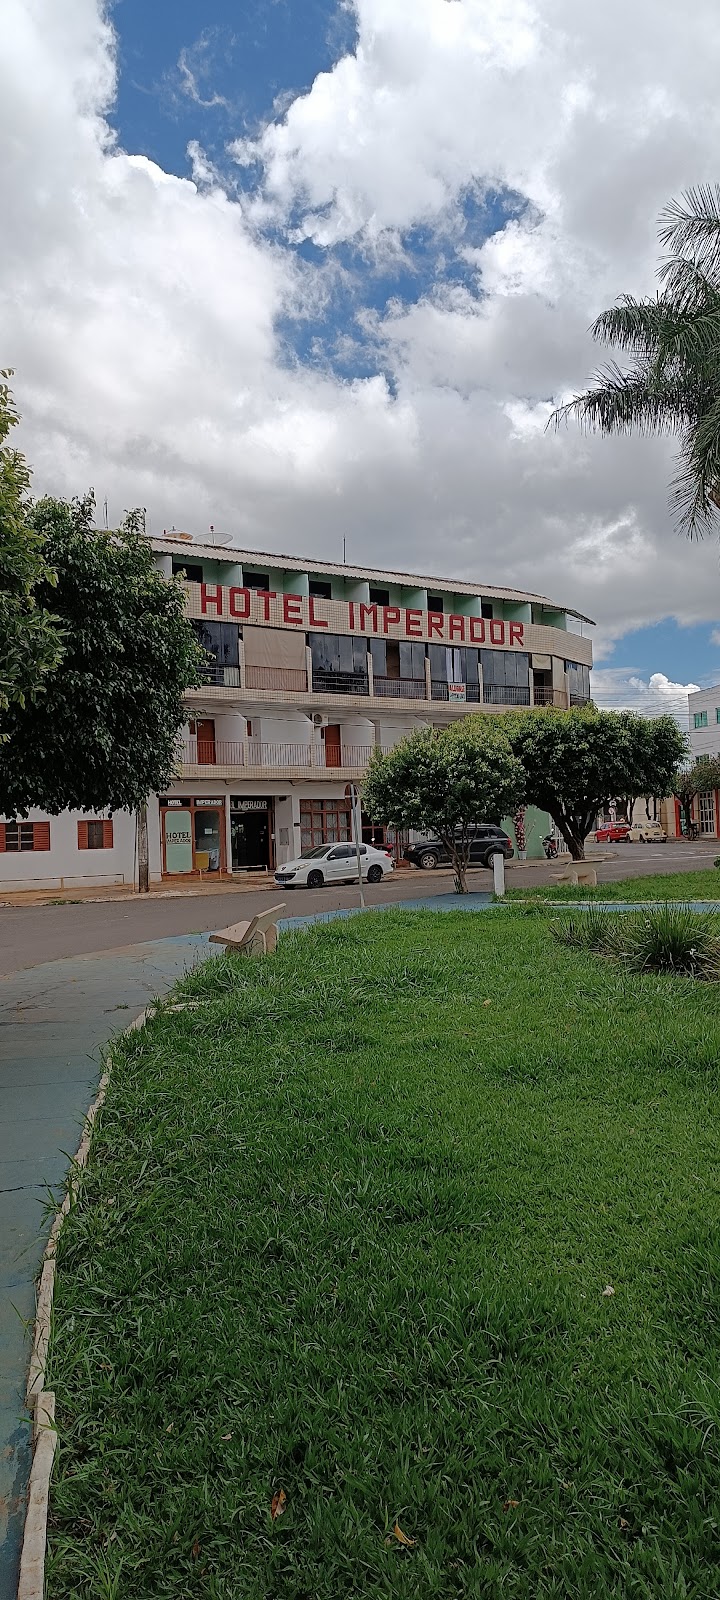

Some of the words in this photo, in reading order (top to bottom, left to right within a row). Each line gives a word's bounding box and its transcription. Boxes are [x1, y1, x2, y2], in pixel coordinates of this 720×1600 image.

[200, 583, 328, 627] HOTEL
[348, 601, 525, 647] IMPERADOR
[238, 800, 267, 809] IMPERADOR
